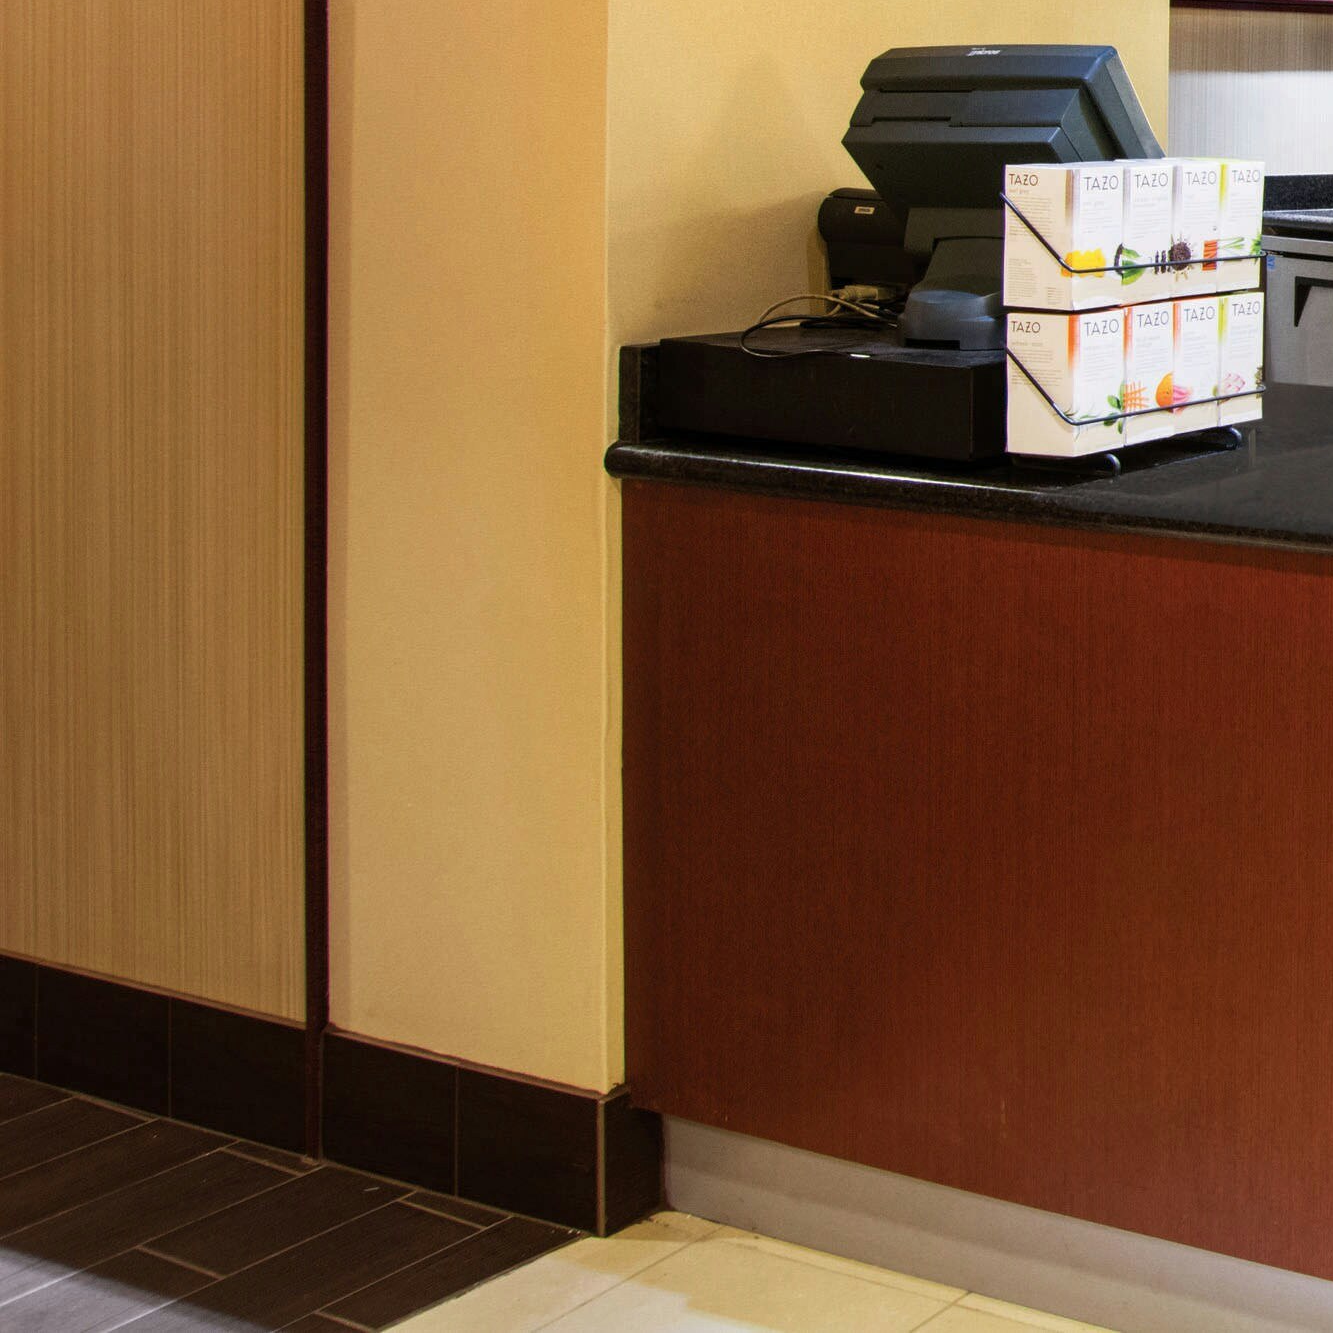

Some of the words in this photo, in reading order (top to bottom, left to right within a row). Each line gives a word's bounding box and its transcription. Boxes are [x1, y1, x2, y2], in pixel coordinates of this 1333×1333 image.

[1008, 173, 1039, 186] TAZO
[1084, 175, 1119, 191] TAZO
[1134, 173, 1169, 188] TAZO
[1185, 171, 1217, 185] TAZO
[1232, 169, 1261, 183] TAZO
[1184, 306, 1215, 322] TAZO
[1232, 301, 1261, 316] TAZO
[1011, 320, 1041, 334] TAZO
[1137, 311, 1169, 328] TAZO
[1084, 319, 1119, 337] TAZO
